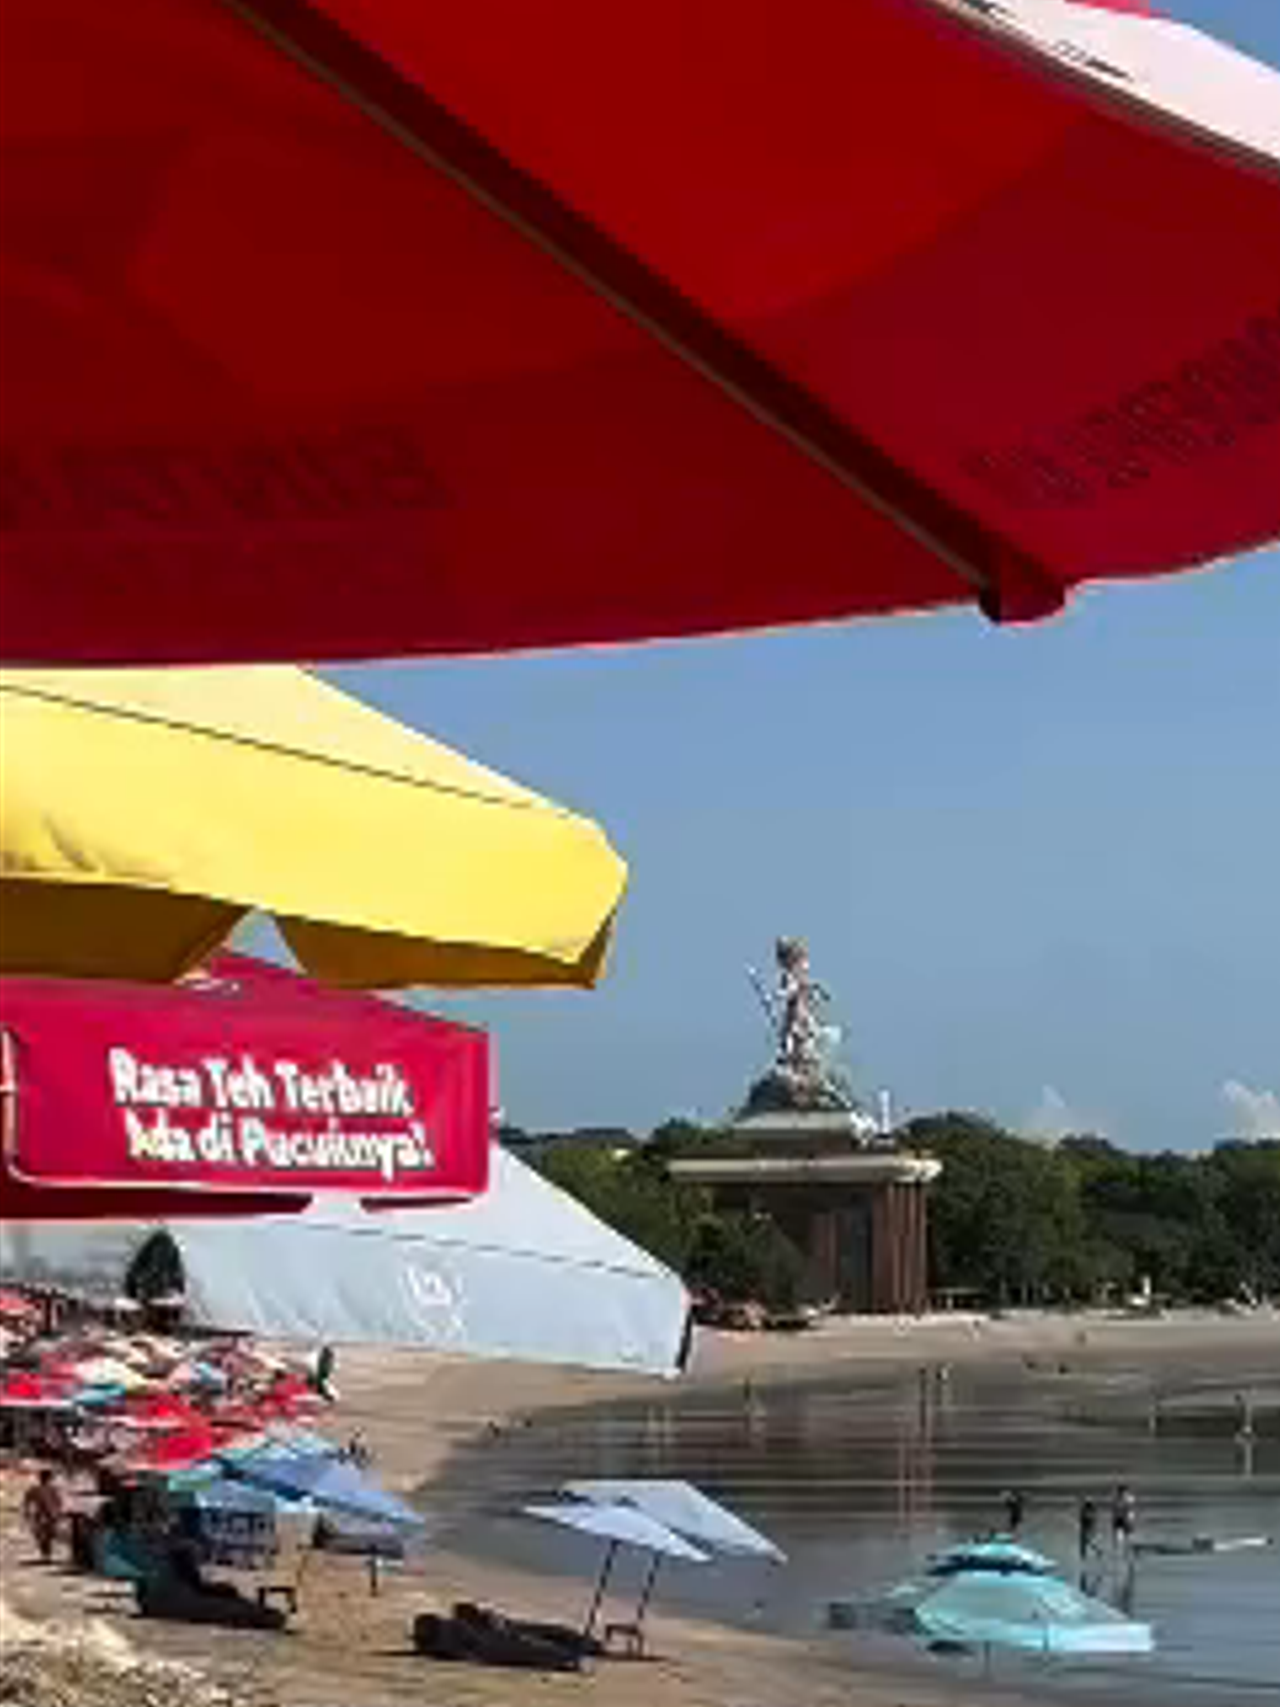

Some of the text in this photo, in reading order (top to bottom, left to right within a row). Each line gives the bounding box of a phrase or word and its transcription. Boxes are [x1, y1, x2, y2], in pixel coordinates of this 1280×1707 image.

[109, 1047, 413, 1117] Rasa Teh Terbaik
[126, 1108, 195, 1162] Ada
[200, 1109, 234, 1162] di
